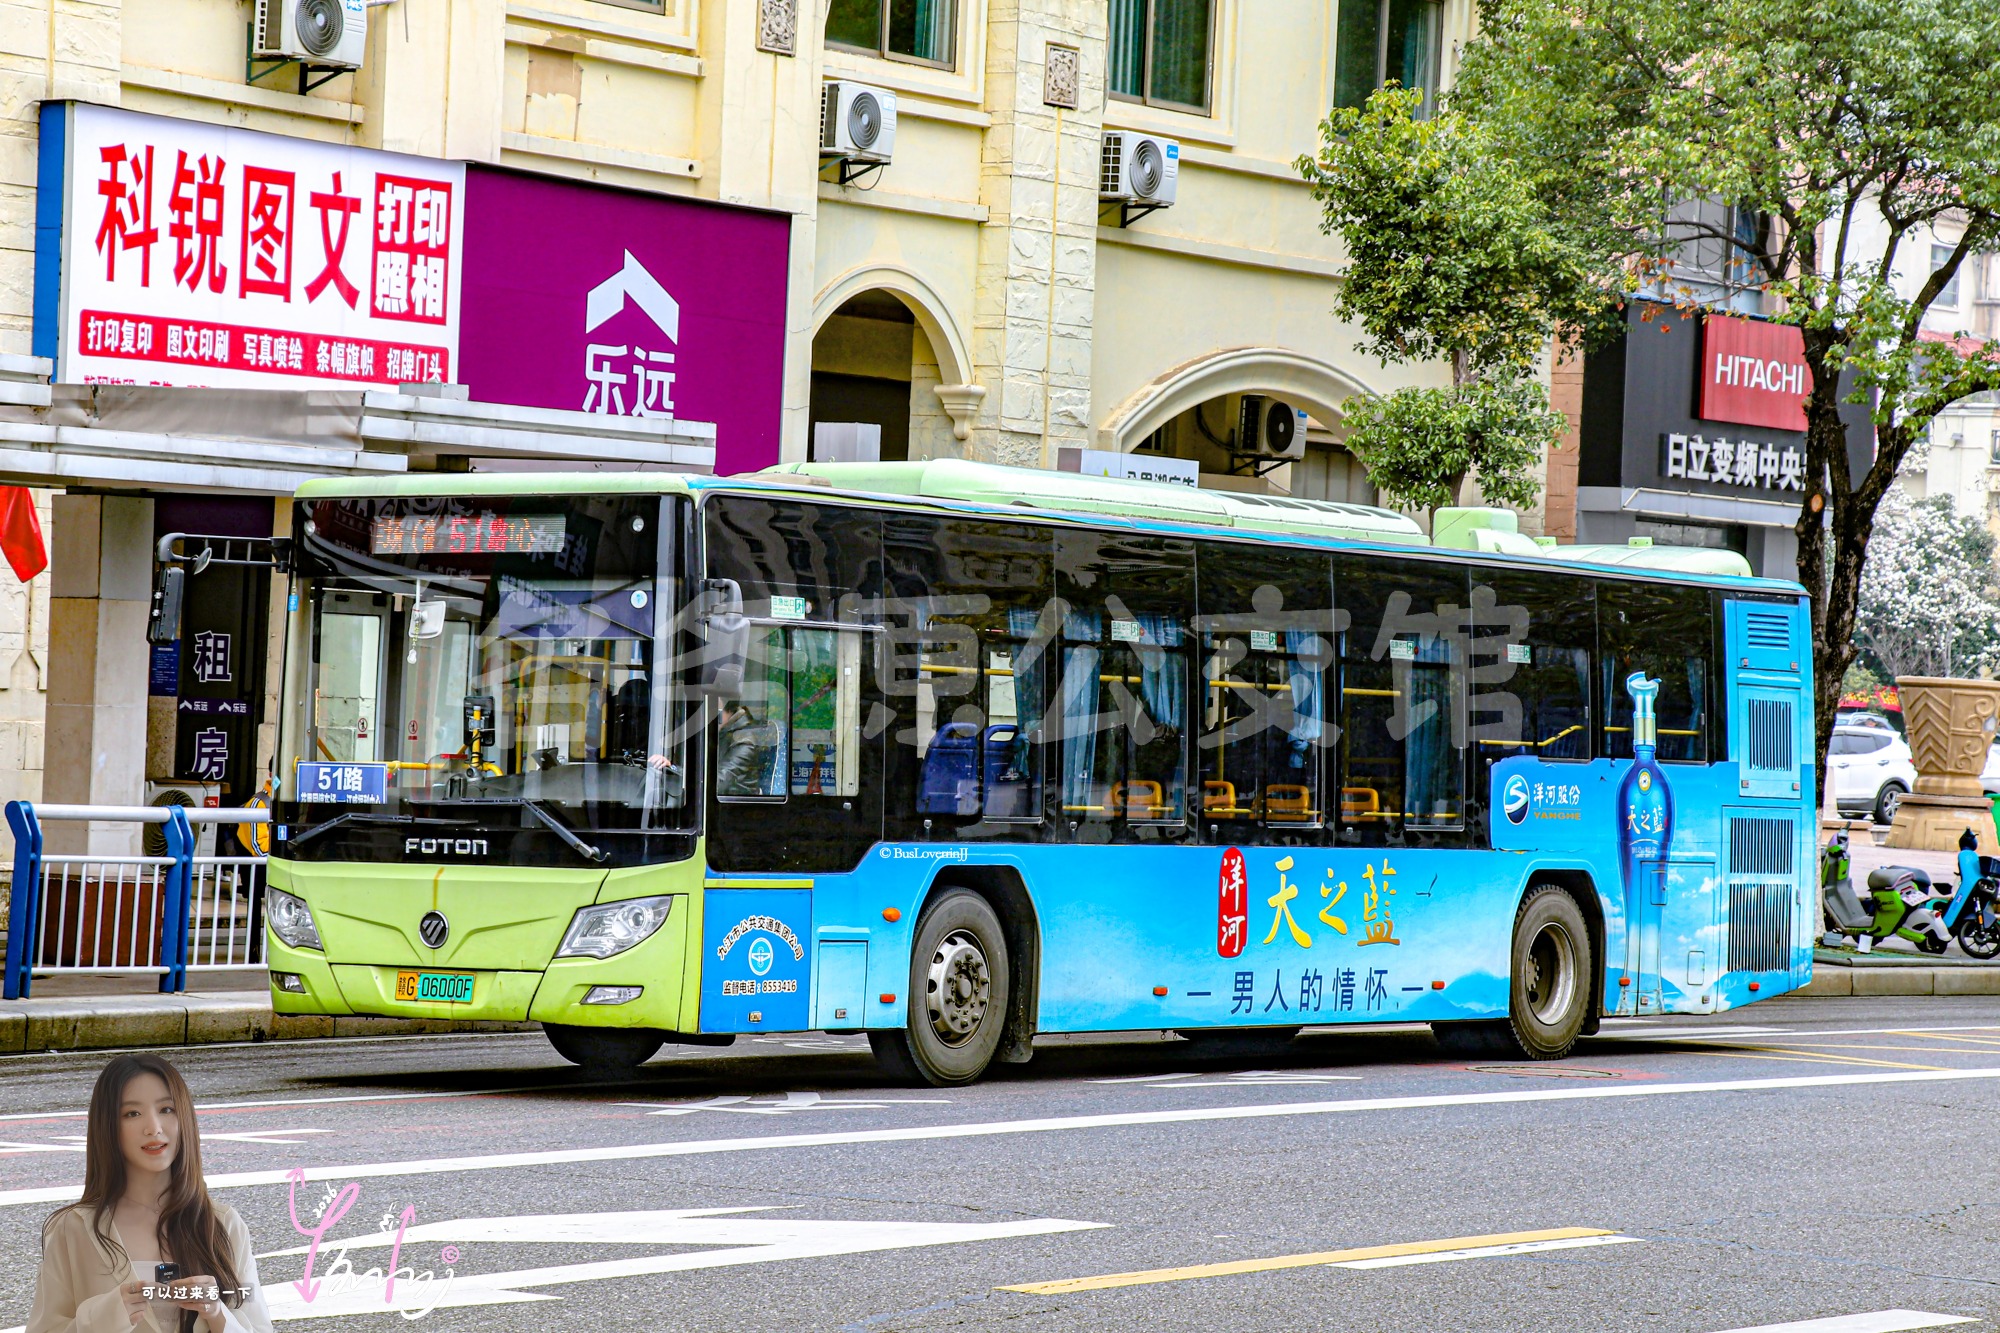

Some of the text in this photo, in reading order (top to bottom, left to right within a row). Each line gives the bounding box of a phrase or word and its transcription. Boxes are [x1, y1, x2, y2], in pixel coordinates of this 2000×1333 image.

[95, 143, 362, 311] 科锐图文
[378, 182, 447, 249] 打印
[374, 251, 446, 318] 照相
[87, 316, 442, 383] 打印复印 图文印刷 写真喷绘 条幅旗帜 招牌门头
[1715, 353, 1804, 394] HITACHI
[582, 343, 676, 419] 乐远
[1667, 433, 1832, 495] 日立变频中央
[191, 630, 232, 780] 租 房
[318, 767, 363, 793] 51路
[1533, 782, 1580, 808] 洋河股份
[405, 838, 488, 855] FOTON
[1533, 811, 1581, 820] YANGHE
[1221, 856, 1246, 953] 洋河
[717, 915, 804, 961] 九江市公共交通集团公司
[1231, 967, 1389, 1015] 男人的情怀
